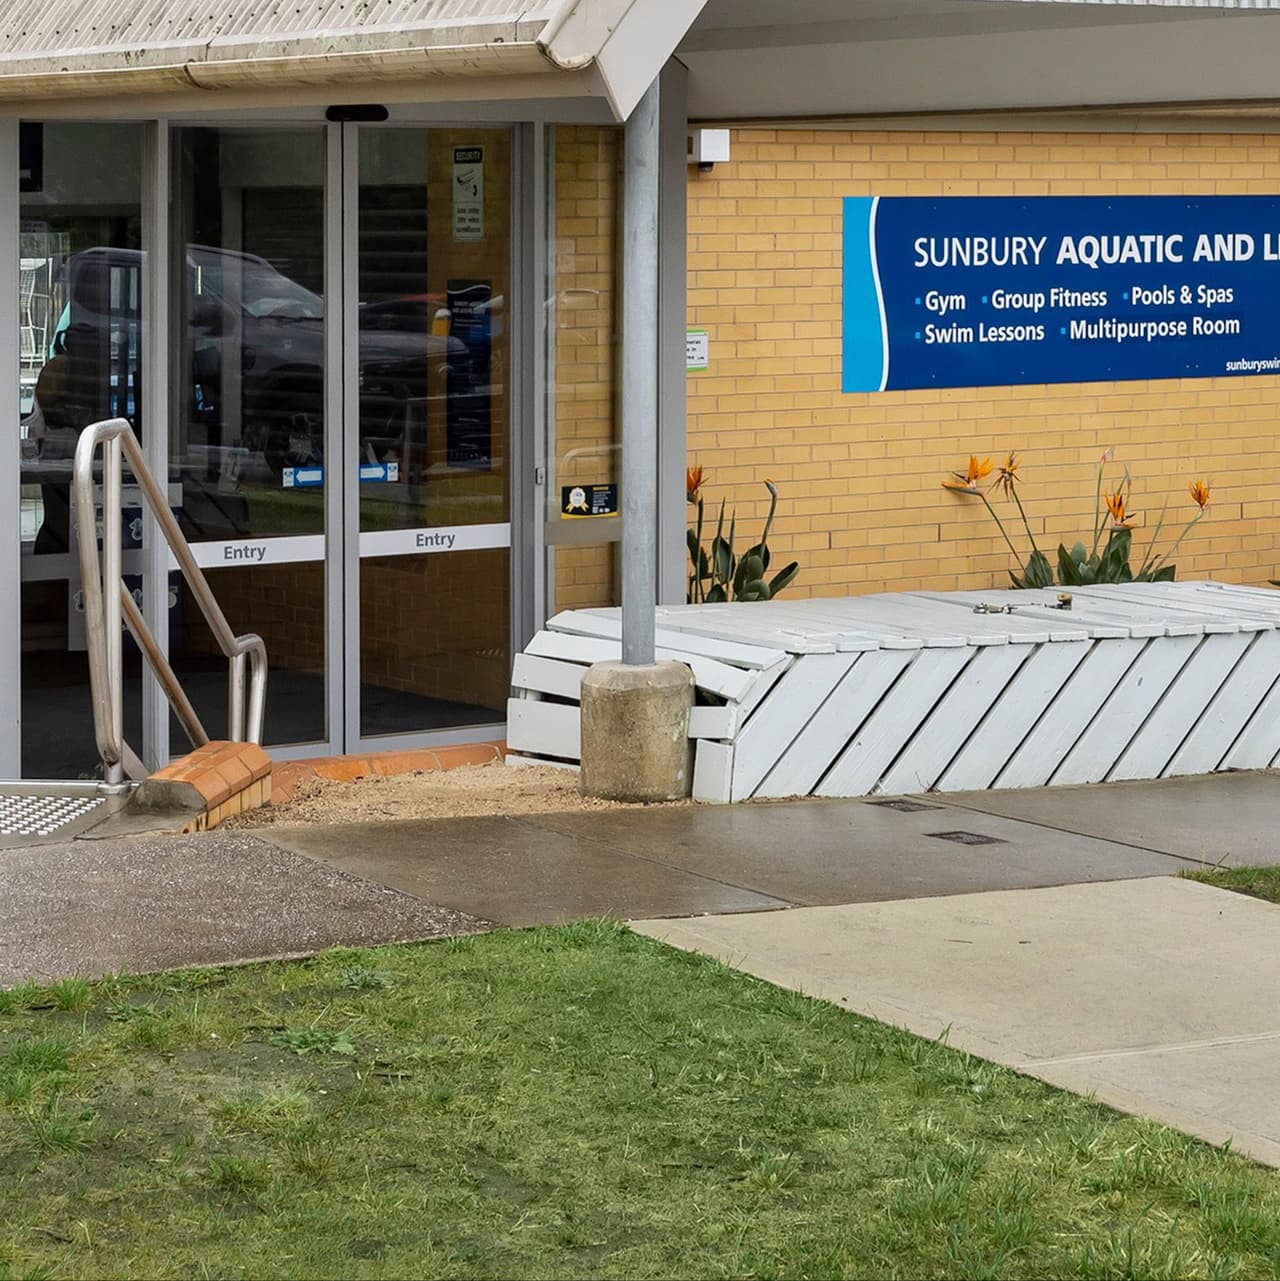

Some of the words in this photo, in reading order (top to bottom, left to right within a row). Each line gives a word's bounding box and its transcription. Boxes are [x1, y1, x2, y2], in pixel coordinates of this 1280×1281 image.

[914, 236, 1047, 268] SUNBURY
[1056, 234, 1183, 269] AQUATIC
[1193, 234, 1255, 262] AND
[925, 291, 966, 315] Gym
[991, 289, 1045, 313] Group
[1050, 287, 1107, 308] Fitness
[1132, 285, 1175, 305] Pools
[1180, 286, 1192, 305] &
[1197, 284, 1234, 308] Spas
[925, 323, 973, 344] Swim
[979, 322, 1045, 342] Lessons
[1070, 318, 1187, 343] Multipurpose
[1193, 317, 1240, 336] Room
[416, 533, 456, 549] Entry
[223, 545, 266, 562] Entry
